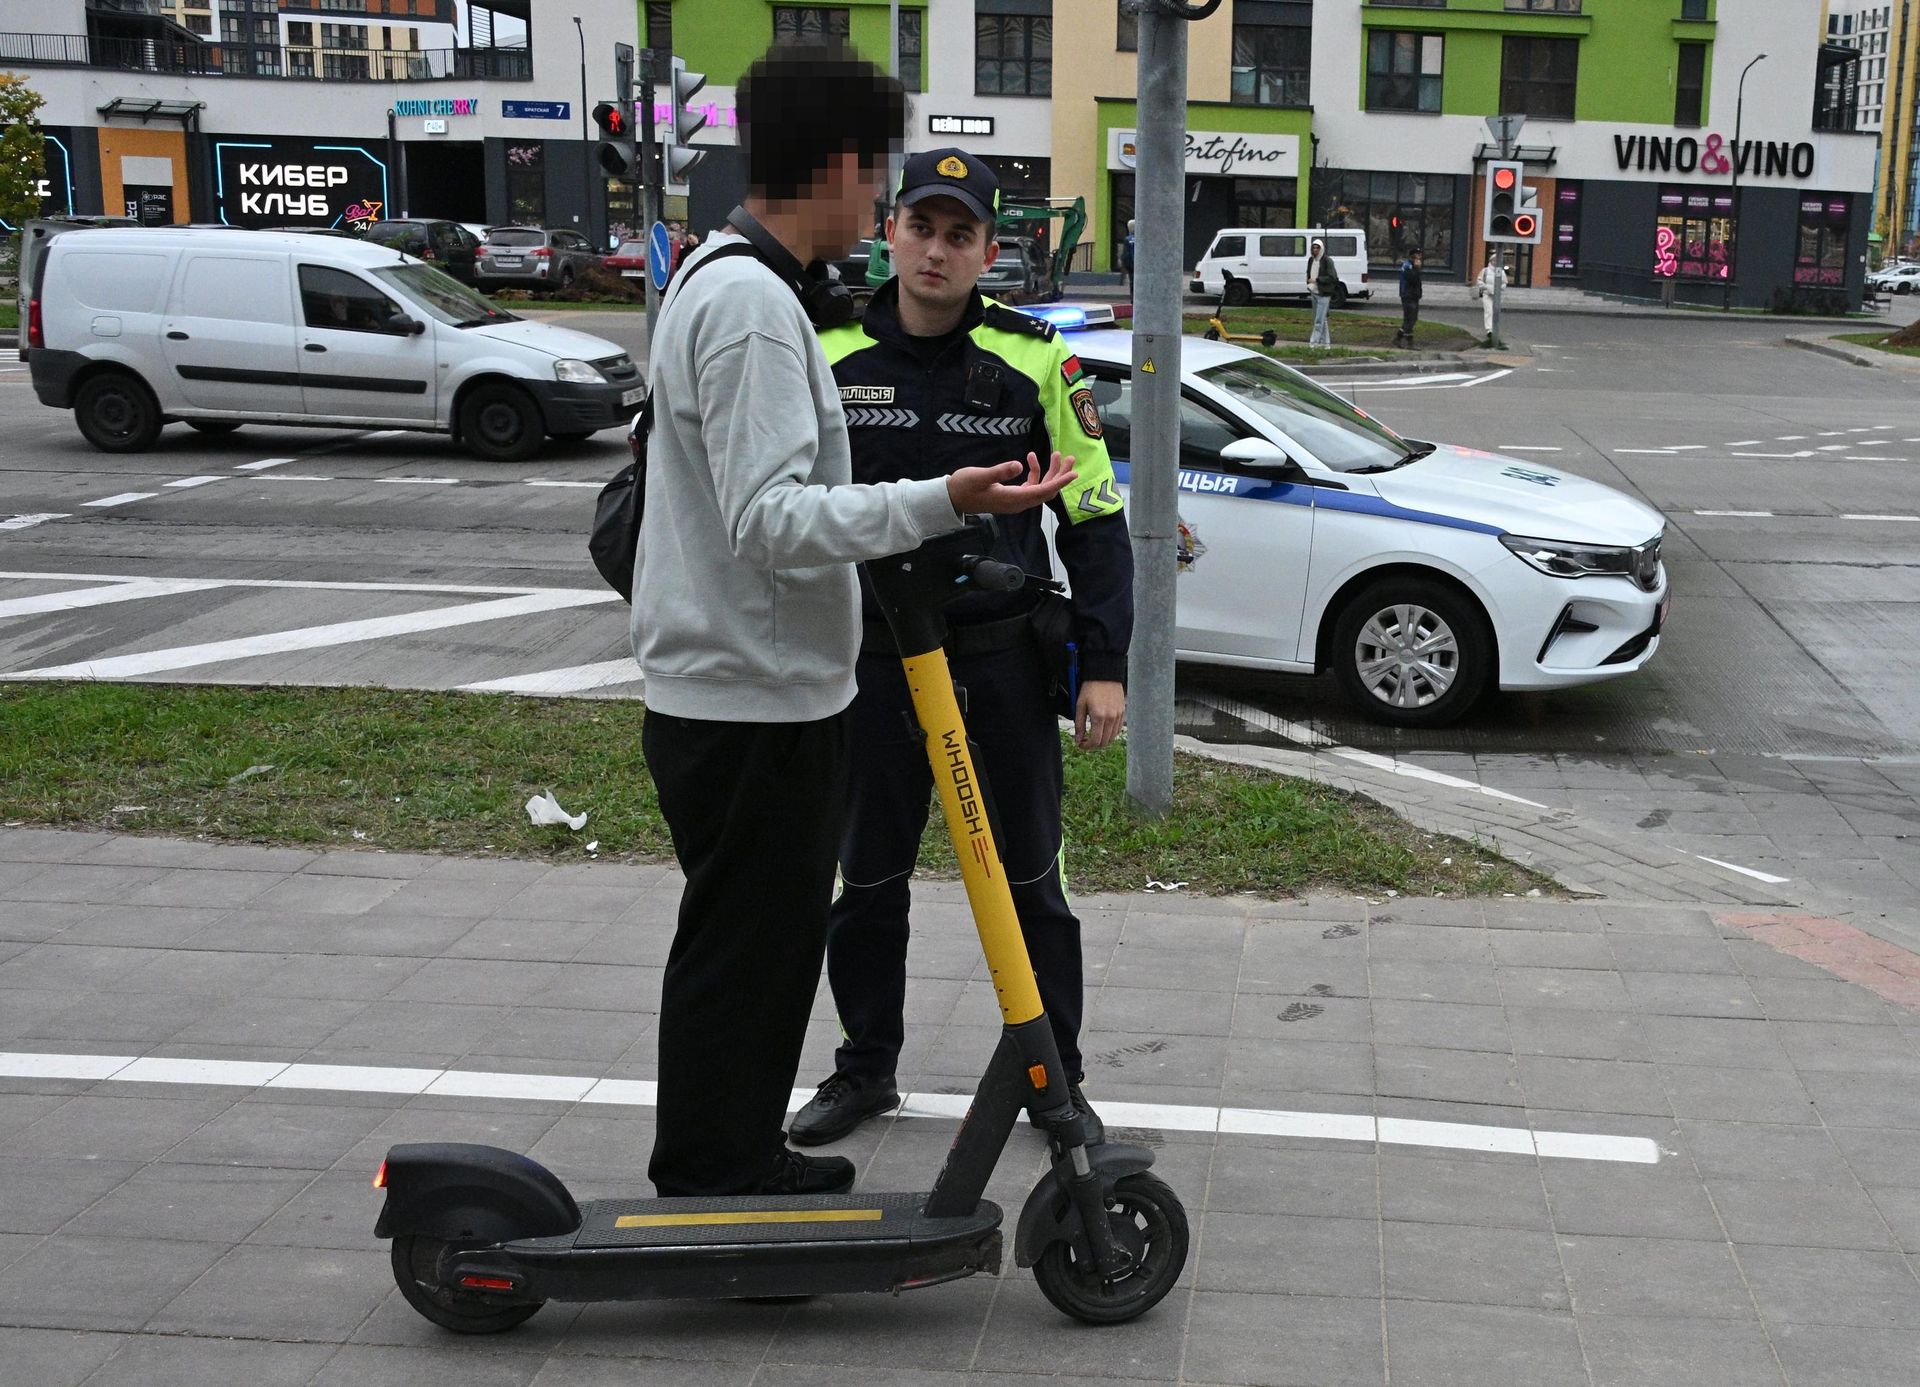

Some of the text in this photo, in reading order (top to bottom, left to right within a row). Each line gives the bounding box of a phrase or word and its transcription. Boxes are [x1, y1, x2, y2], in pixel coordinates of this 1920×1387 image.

[395, 98, 478, 117] KUHNI CHERRY
[556, 104, 565, 117] 7
[239, 163, 348, 188] КИБЕР
[241, 192, 329, 216] КЛУБ
[345, 204, 373, 220] Bar
[1003, 209, 1024, 217] JCB
[354, 221, 375, 231] 24/
[942, 729, 984, 836] WHOOSH
